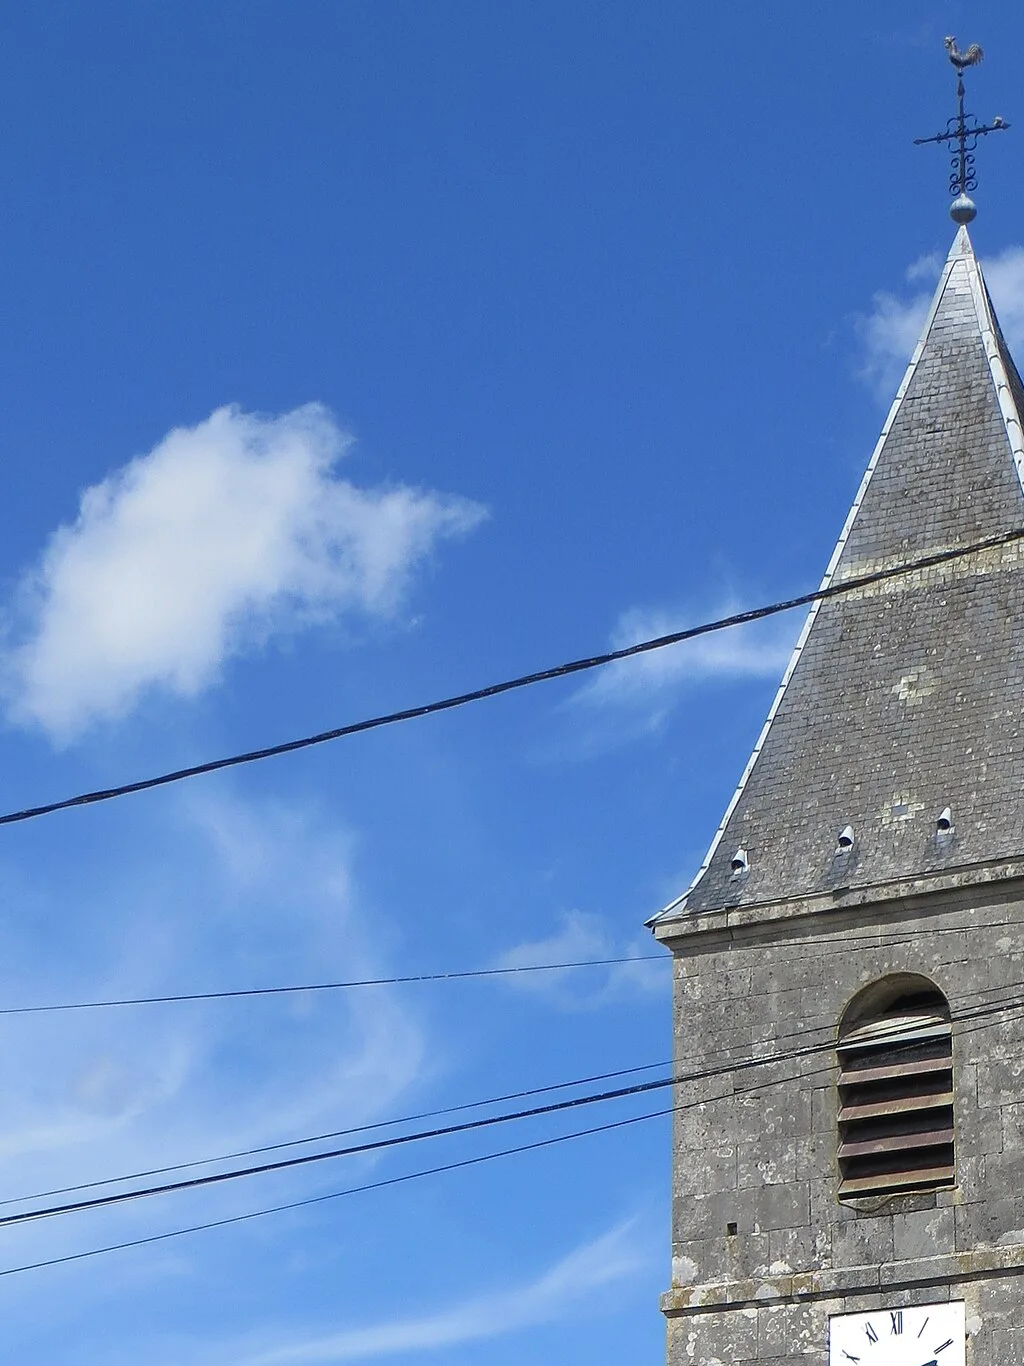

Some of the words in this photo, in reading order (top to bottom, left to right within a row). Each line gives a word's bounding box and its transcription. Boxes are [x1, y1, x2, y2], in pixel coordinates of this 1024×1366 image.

[861, 1321, 879, 1346] XI
[890, 1311, 903, 1336] XII
[933, 1338, 954, 1355] II
